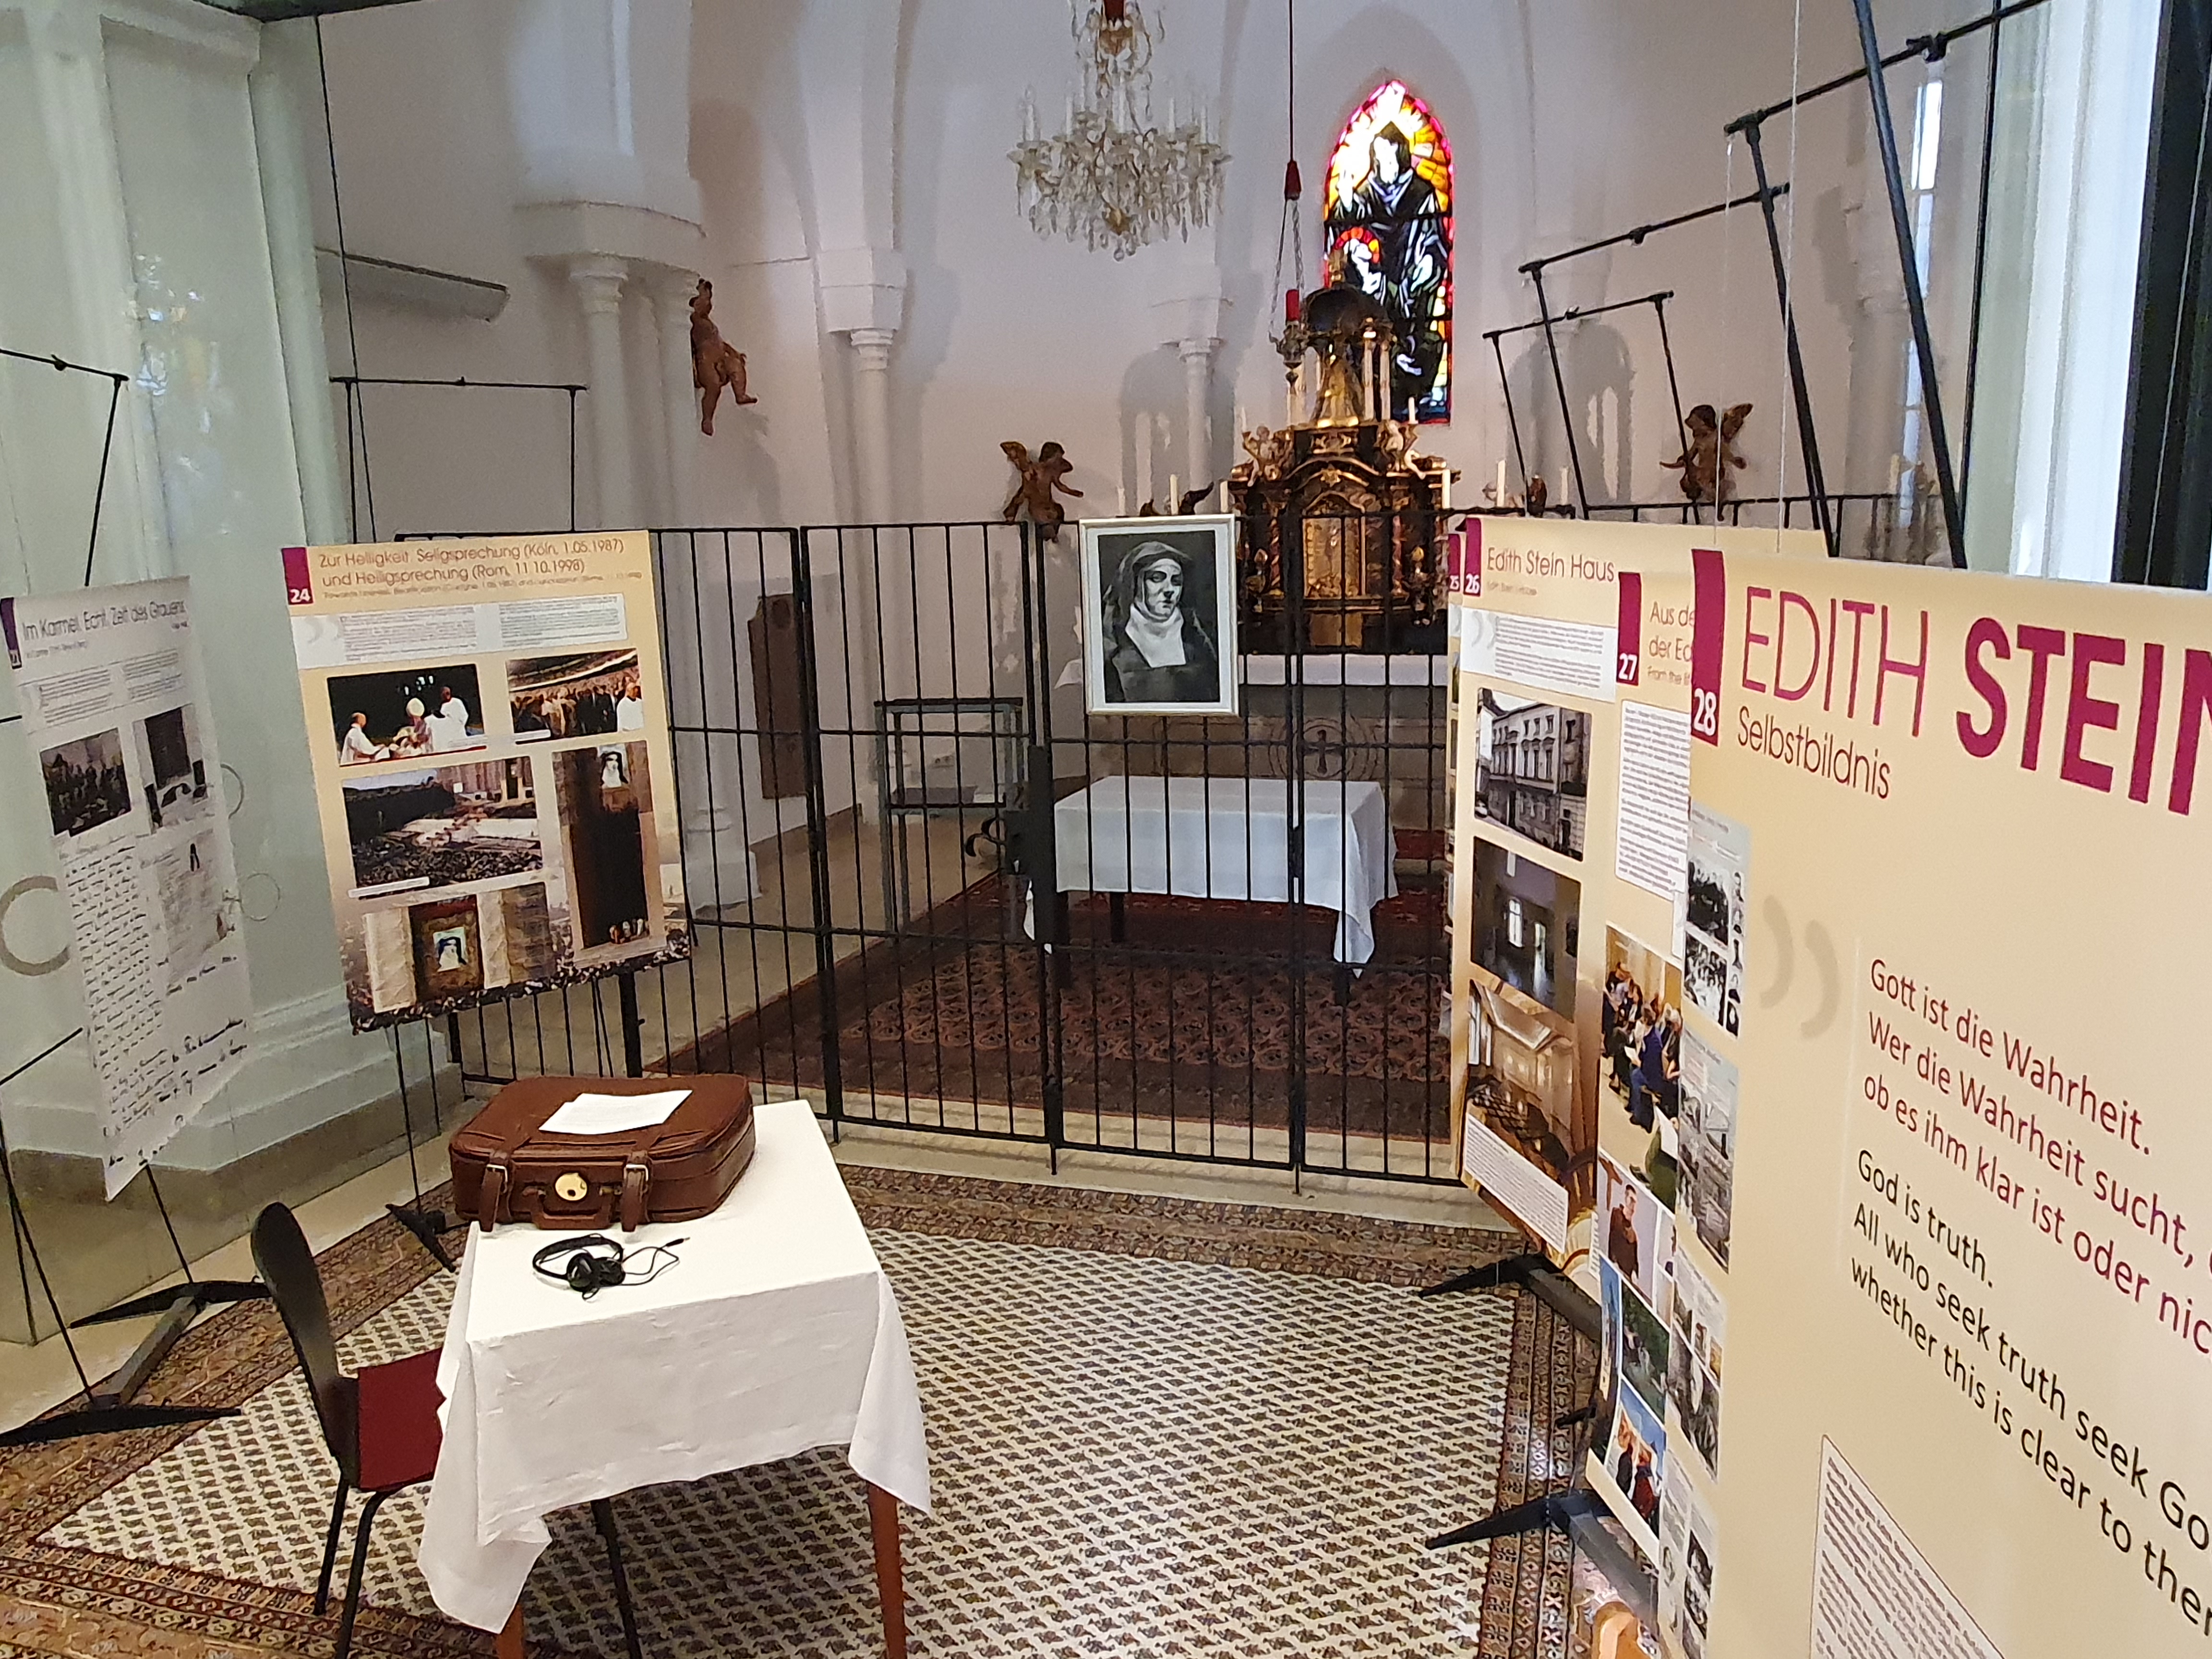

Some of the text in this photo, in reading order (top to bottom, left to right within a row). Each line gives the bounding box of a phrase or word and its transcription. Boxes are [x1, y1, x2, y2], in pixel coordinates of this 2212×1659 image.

[319, 554, 340, 567] Zur
[323, 572, 351, 587] und
[1465, 574, 1479, 594] 26
[1488, 547, 1614, 582] Edith Stein Haus
[290, 589, 310, 602] 24
[1650, 601, 1674, 625] Aus
[1619, 653, 1637, 681] 27
[1649, 635, 1671, 659] der
[1742, 587, 1928, 736] EDITH
[1694, 688, 1717, 736] 28
[1738, 706, 1890, 799] Selbstbildnis
[1872, 959, 2149, 1154] Gott ist die Wahrheit.
[1869, 1011, 2193, 1268] Wer die Wahrheit sucht,
[1864, 1074, 1888, 1110] ob
[1895, 1099, 1917, 1131] es
[1924, 1110, 1967, 1170] ihm
[1976, 1146, 2024, 1209] klar
[2032, 1189, 2065, 1244] ist
[2074, 1231, 2150, 1303] oder
[1859, 1150, 1993, 1287] God is truth.
[1854, 1203, 2212, 1550] All who seek truth seek Go
[1851, 1258, 1936, 1357] whether
[1944, 1345, 1984, 1408] this
[1994, 1391, 2012, 1435] is
[2021, 1429, 2090, 1509] clear
[2100, 1498, 2131, 1552] to
